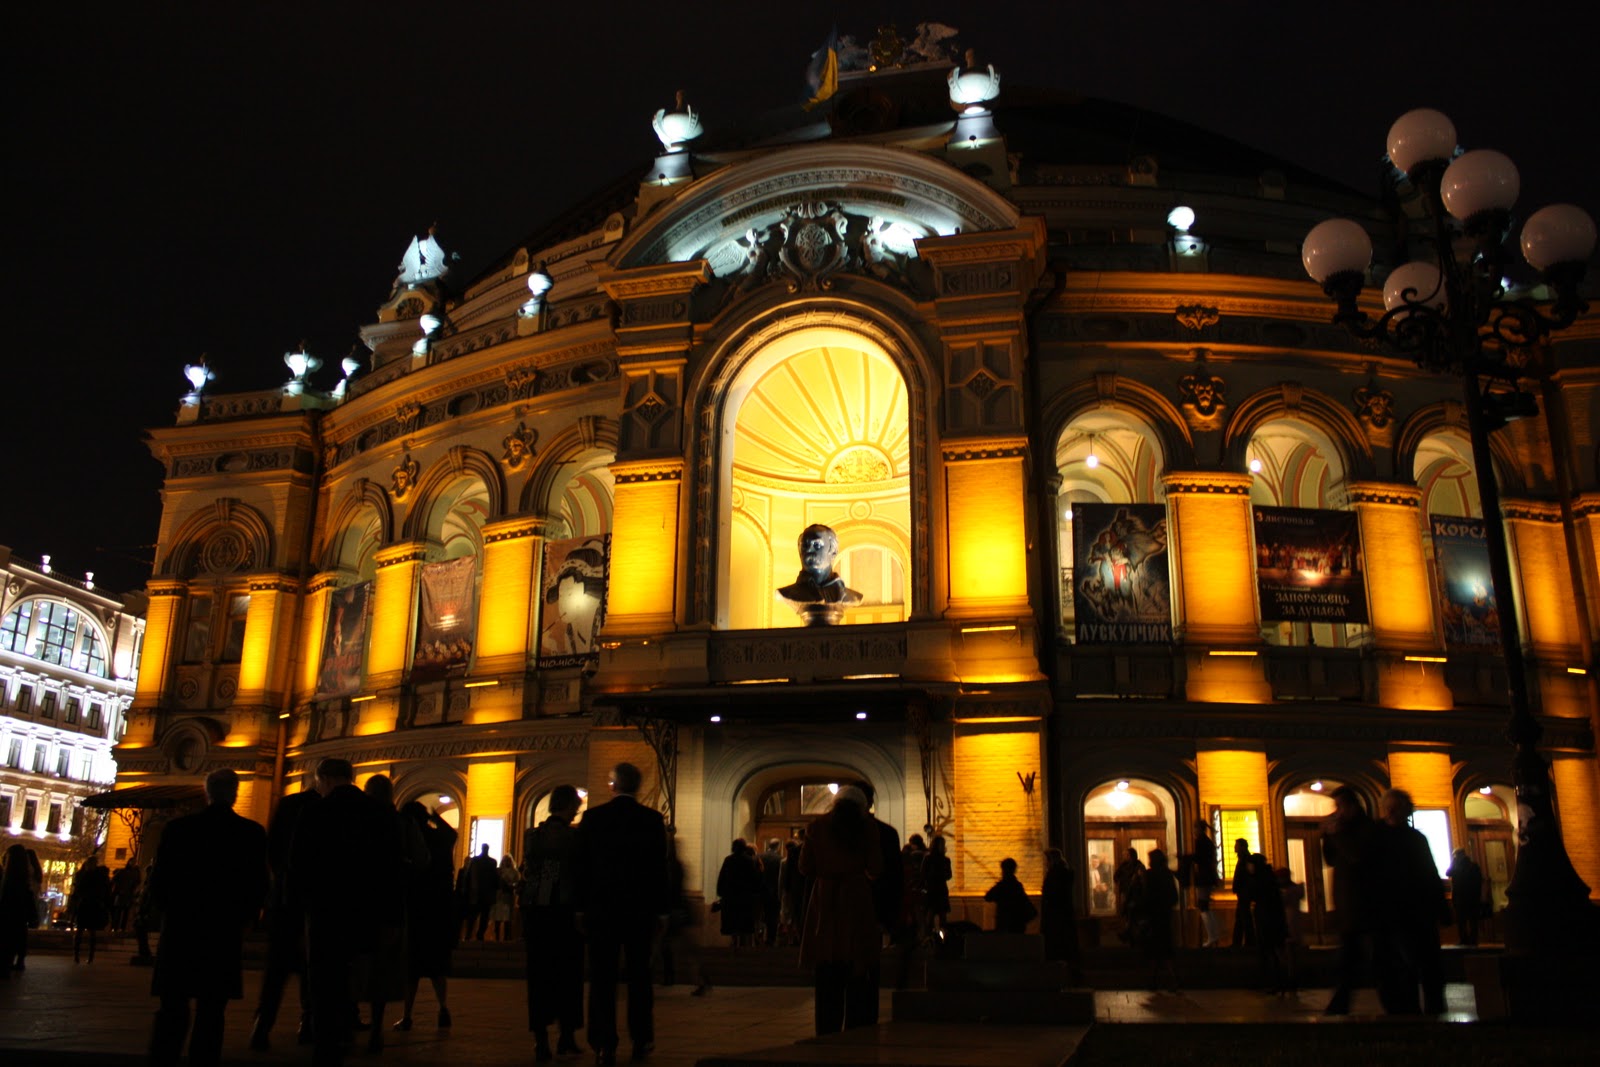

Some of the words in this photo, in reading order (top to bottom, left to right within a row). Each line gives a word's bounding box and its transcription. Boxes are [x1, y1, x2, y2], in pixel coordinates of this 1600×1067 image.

[1256, 511, 1264, 522] 3
[1434, 522, 1488, 539] КОРСА
[1281, 605, 1296, 616] ЗА
[1079, 623, 1170, 642] ЛУСКУНЧИК
